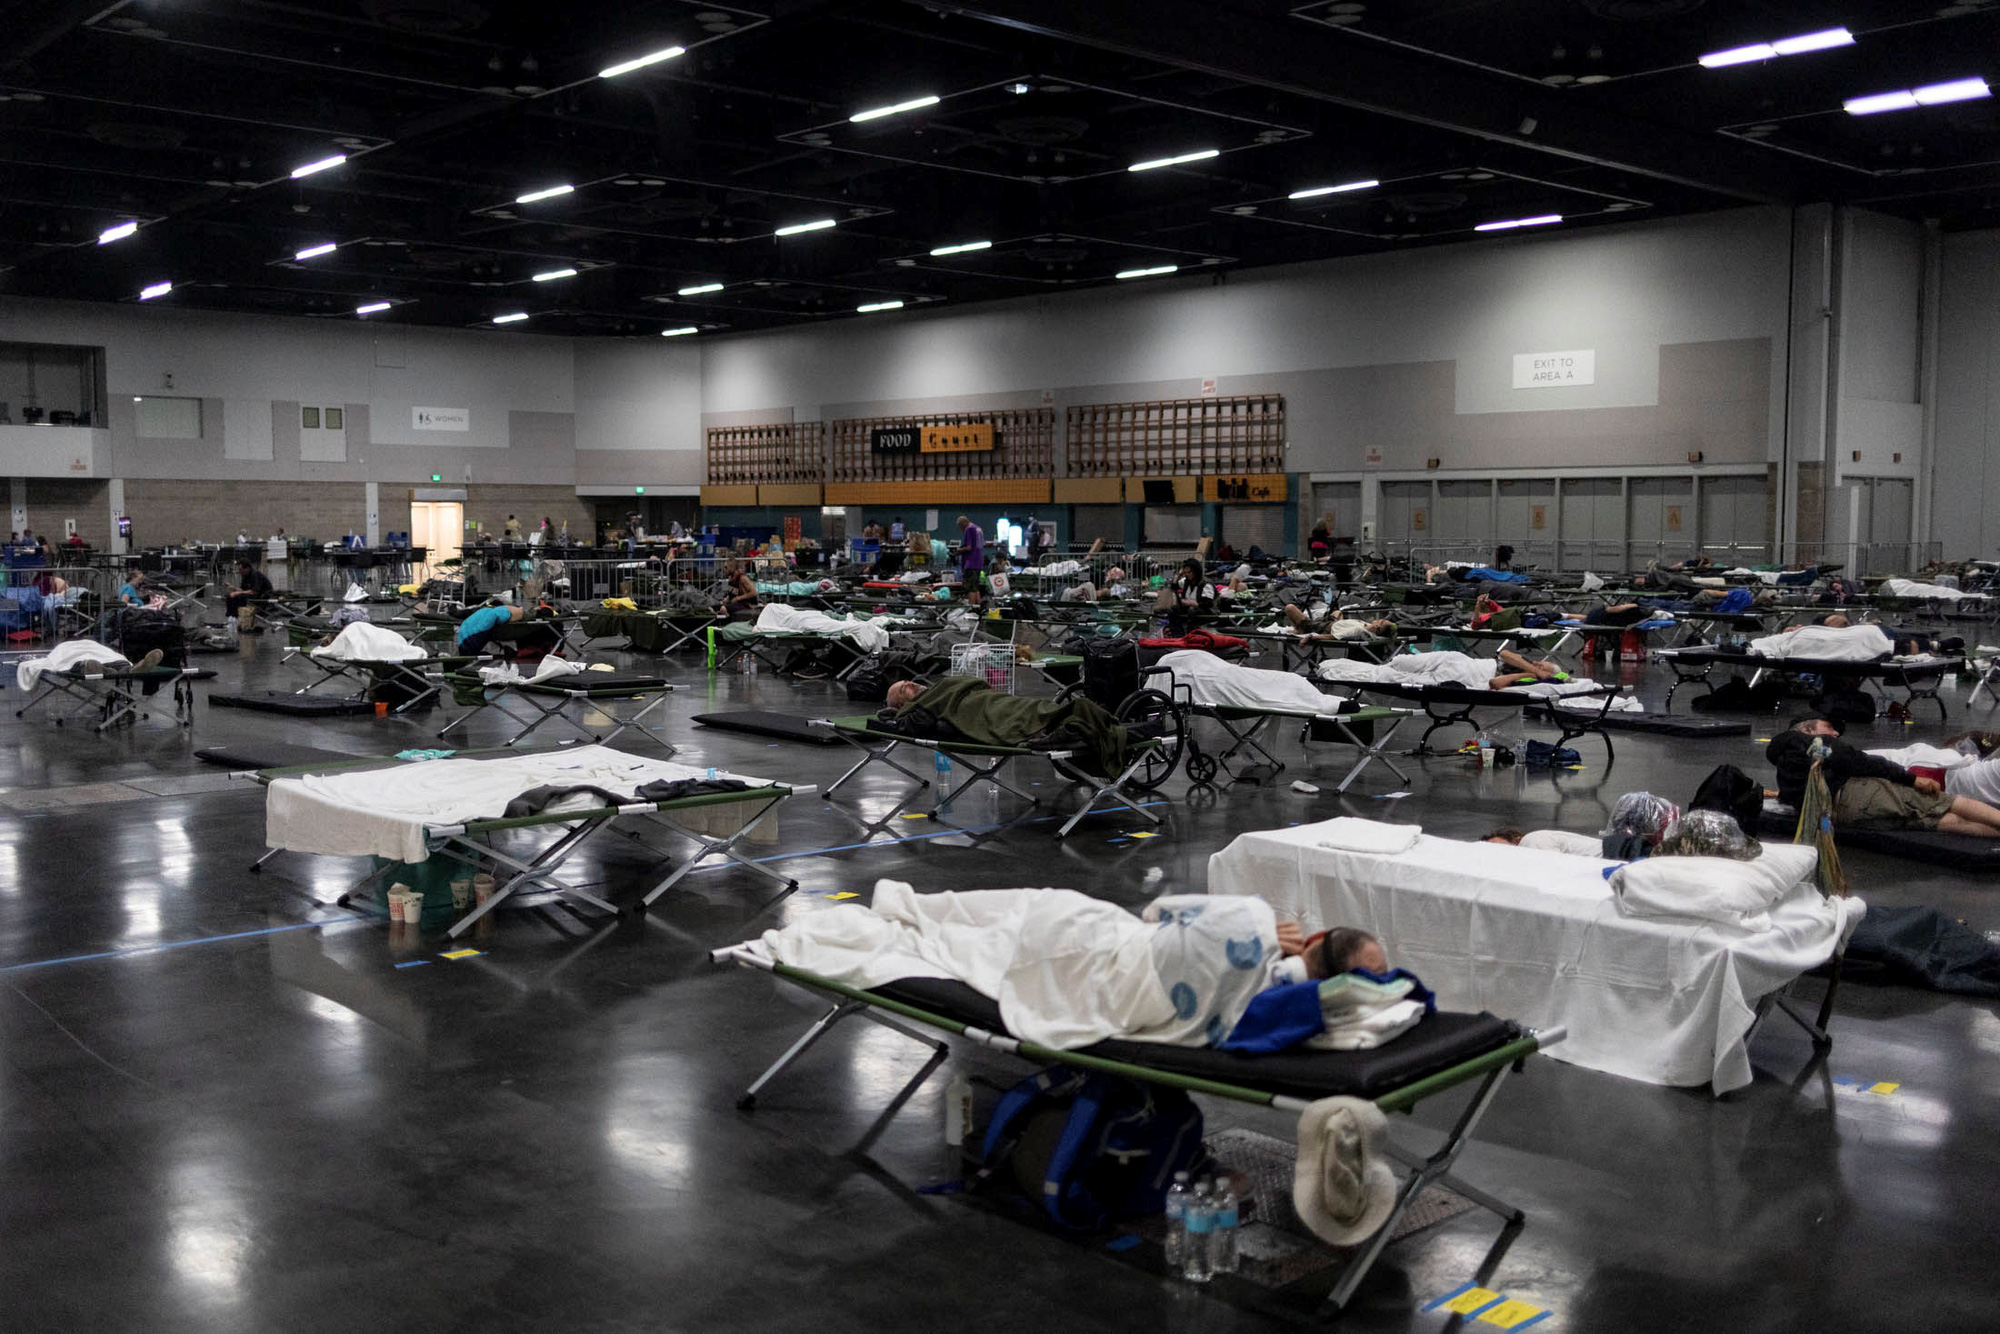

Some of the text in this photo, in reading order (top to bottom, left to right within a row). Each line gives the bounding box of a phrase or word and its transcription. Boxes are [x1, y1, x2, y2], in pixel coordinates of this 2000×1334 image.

[1534, 358, 1574, 369] EXIT TO
[1533, 370, 1574, 381] AREA A
[879, 433, 912, 448] FOOD
